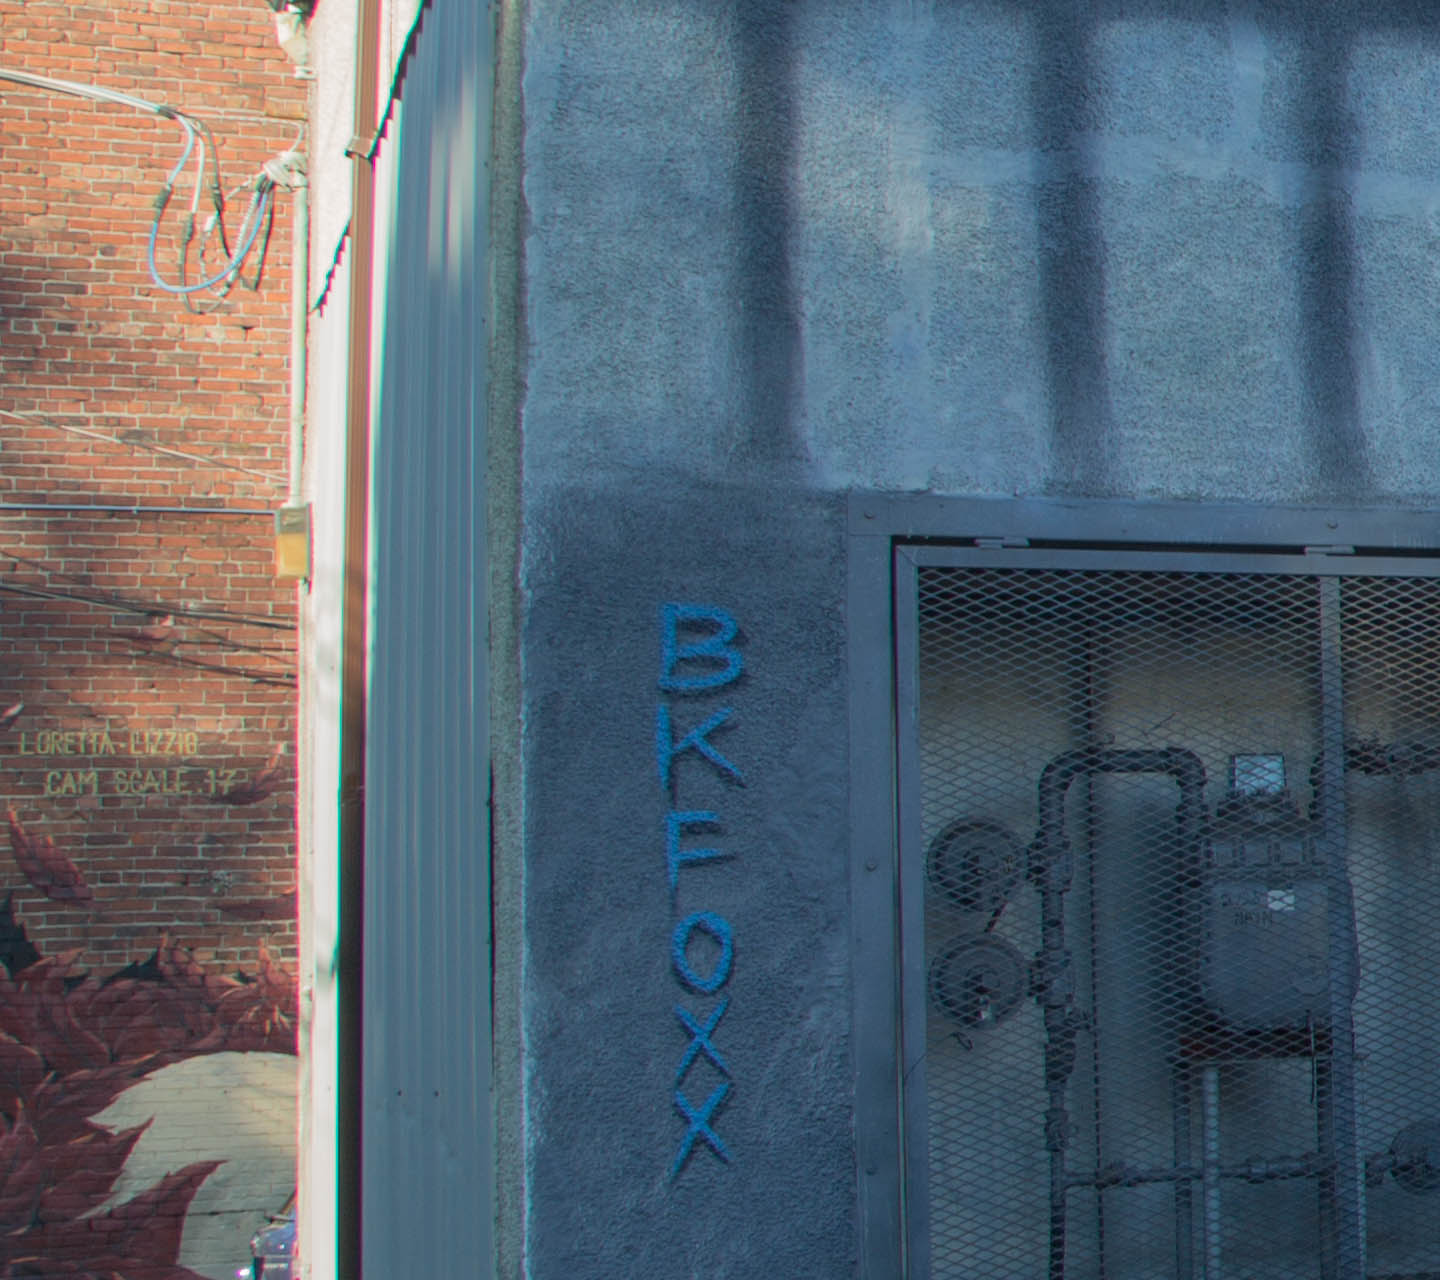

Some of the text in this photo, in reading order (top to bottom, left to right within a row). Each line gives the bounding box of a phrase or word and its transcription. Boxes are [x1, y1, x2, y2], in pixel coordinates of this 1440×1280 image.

[47, 771, 99, 795] CAM
[114, 770, 189, 794] SCALE
[657, 602, 746, 1183] BKFOXX
